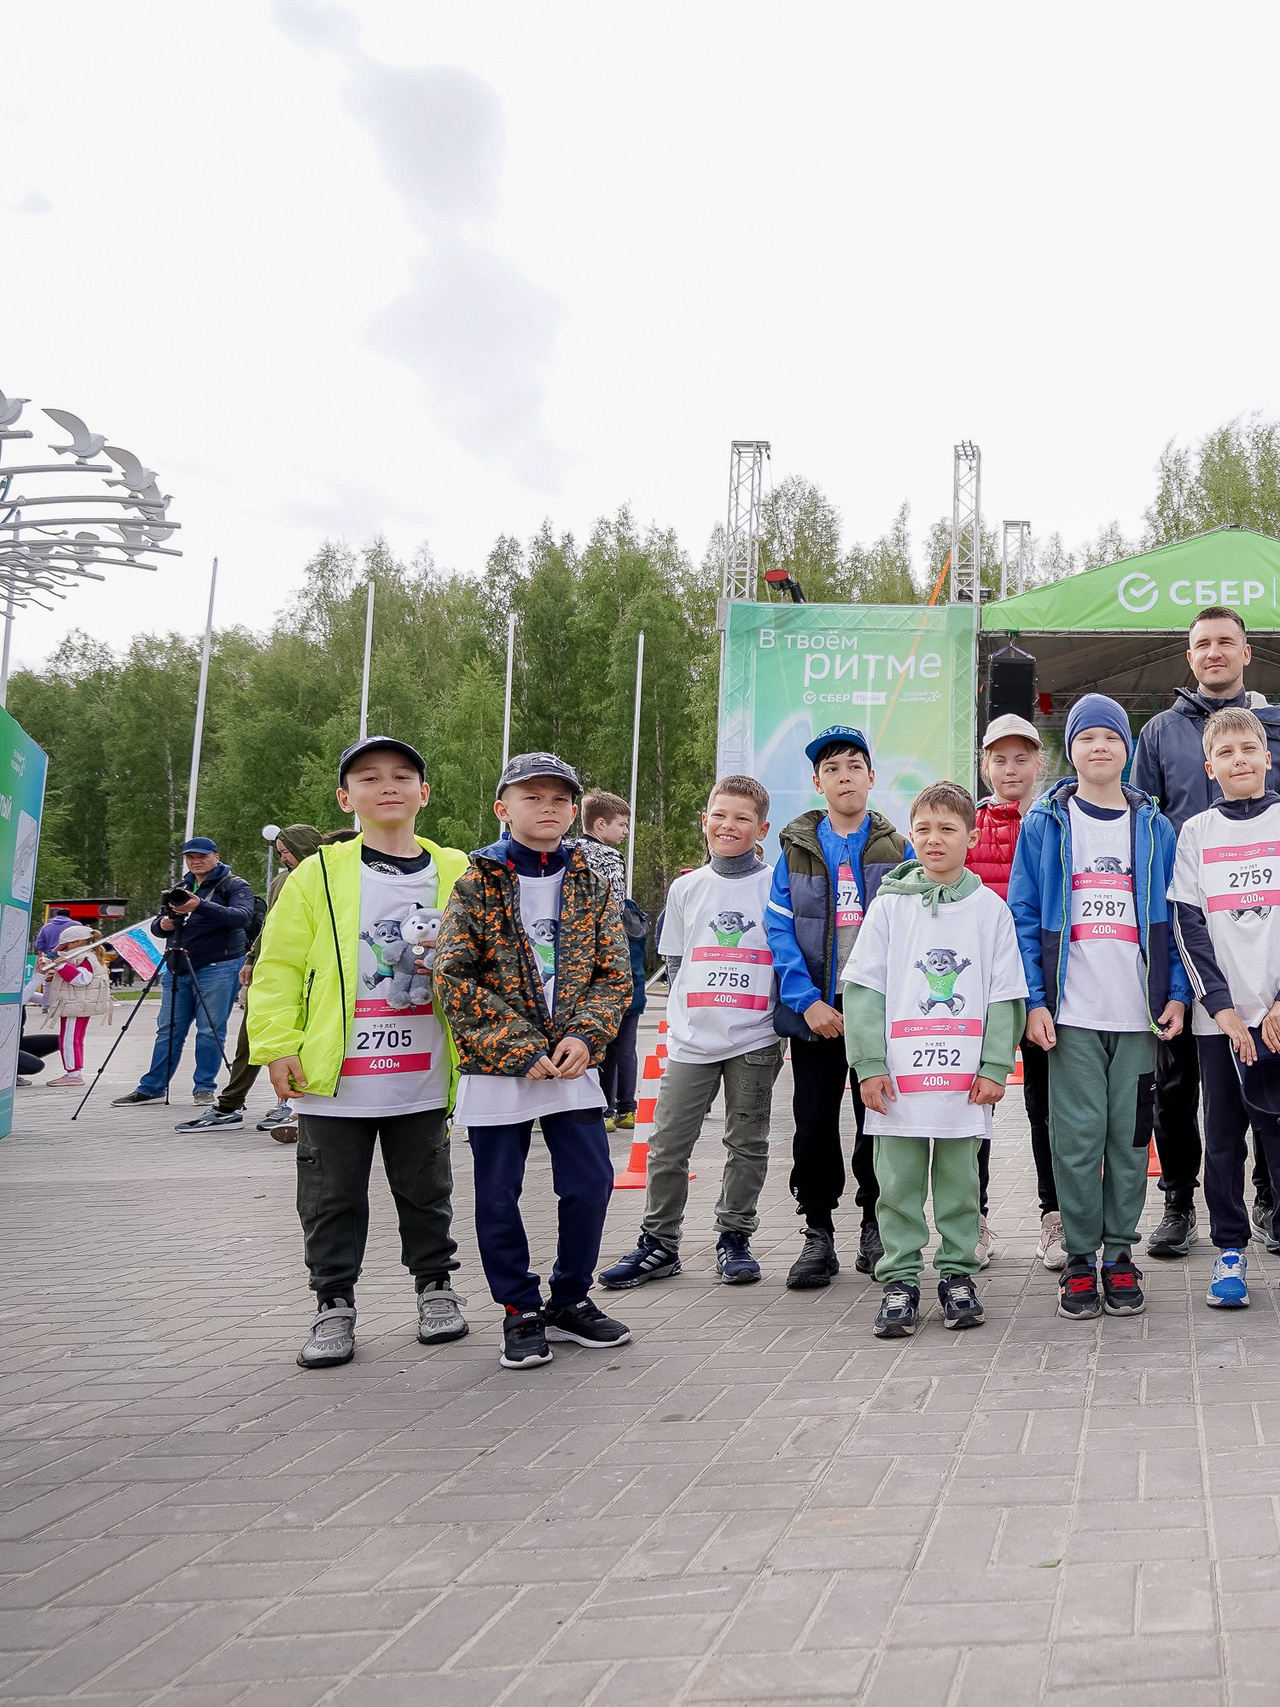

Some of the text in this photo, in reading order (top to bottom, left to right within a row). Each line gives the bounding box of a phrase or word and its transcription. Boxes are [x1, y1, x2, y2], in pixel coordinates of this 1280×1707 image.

[1169, 580, 1264, 606] СБЕР
[760, 628, 858, 650] В твоём
[804, 652, 942, 688] ритме
[819, 692, 851, 702] СБЕР
[1228, 868, 1272, 888] 2759
[1240, 894, 1264, 904] 400м
[1082, 900, 1126, 917] 2987
[1092, 925, 1117, 934] 400м
[707, 972, 750, 988] 2758
[714, 995, 738, 1004] 400м
[356, 1030, 412, 1050] 2705
[369, 1058, 400, 1070] 400м
[912, 1049, 960, 1067] 2752
[922, 1076, 950, 1086] 400м
